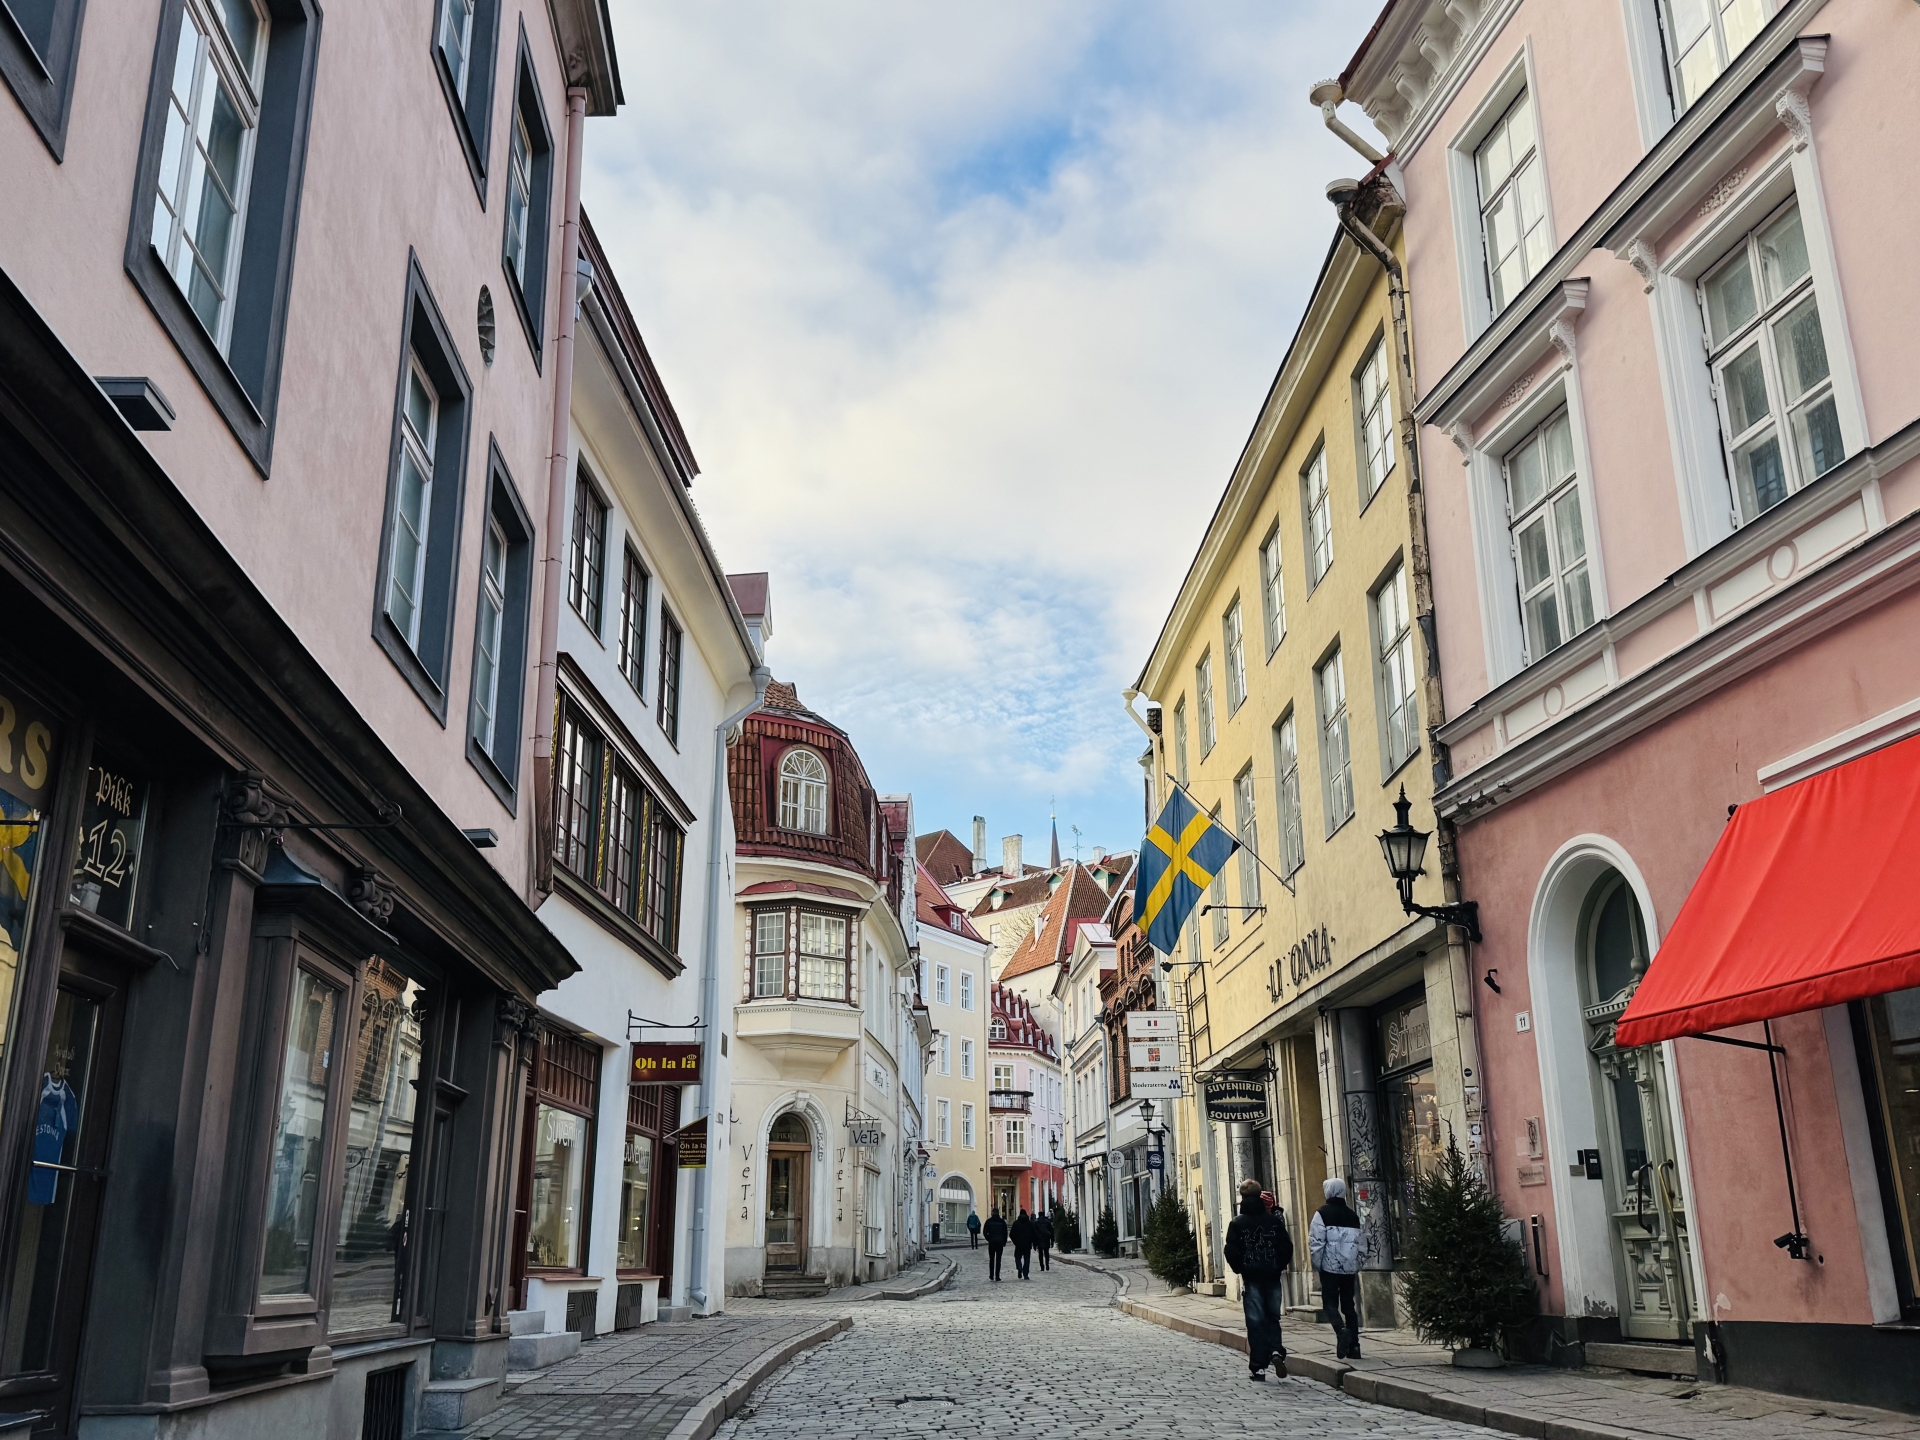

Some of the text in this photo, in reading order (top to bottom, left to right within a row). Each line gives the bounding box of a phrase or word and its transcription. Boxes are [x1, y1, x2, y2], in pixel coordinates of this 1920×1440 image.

[96, 767, 132, 817] Pikk
[84, 819, 127, 888] 12
[1519, 1016, 1526, 1028] 11
[635, 1057, 657, 1069] Oh
[661, 1057, 676, 1069] la
[1207, 1082, 1262, 1093] SUVENIIRID
[1210, 1110, 1265, 1120] SOUVENIRS
[36, 1123, 59, 1141] ESTONIA
[852, 1129, 879, 1146] VeTa
